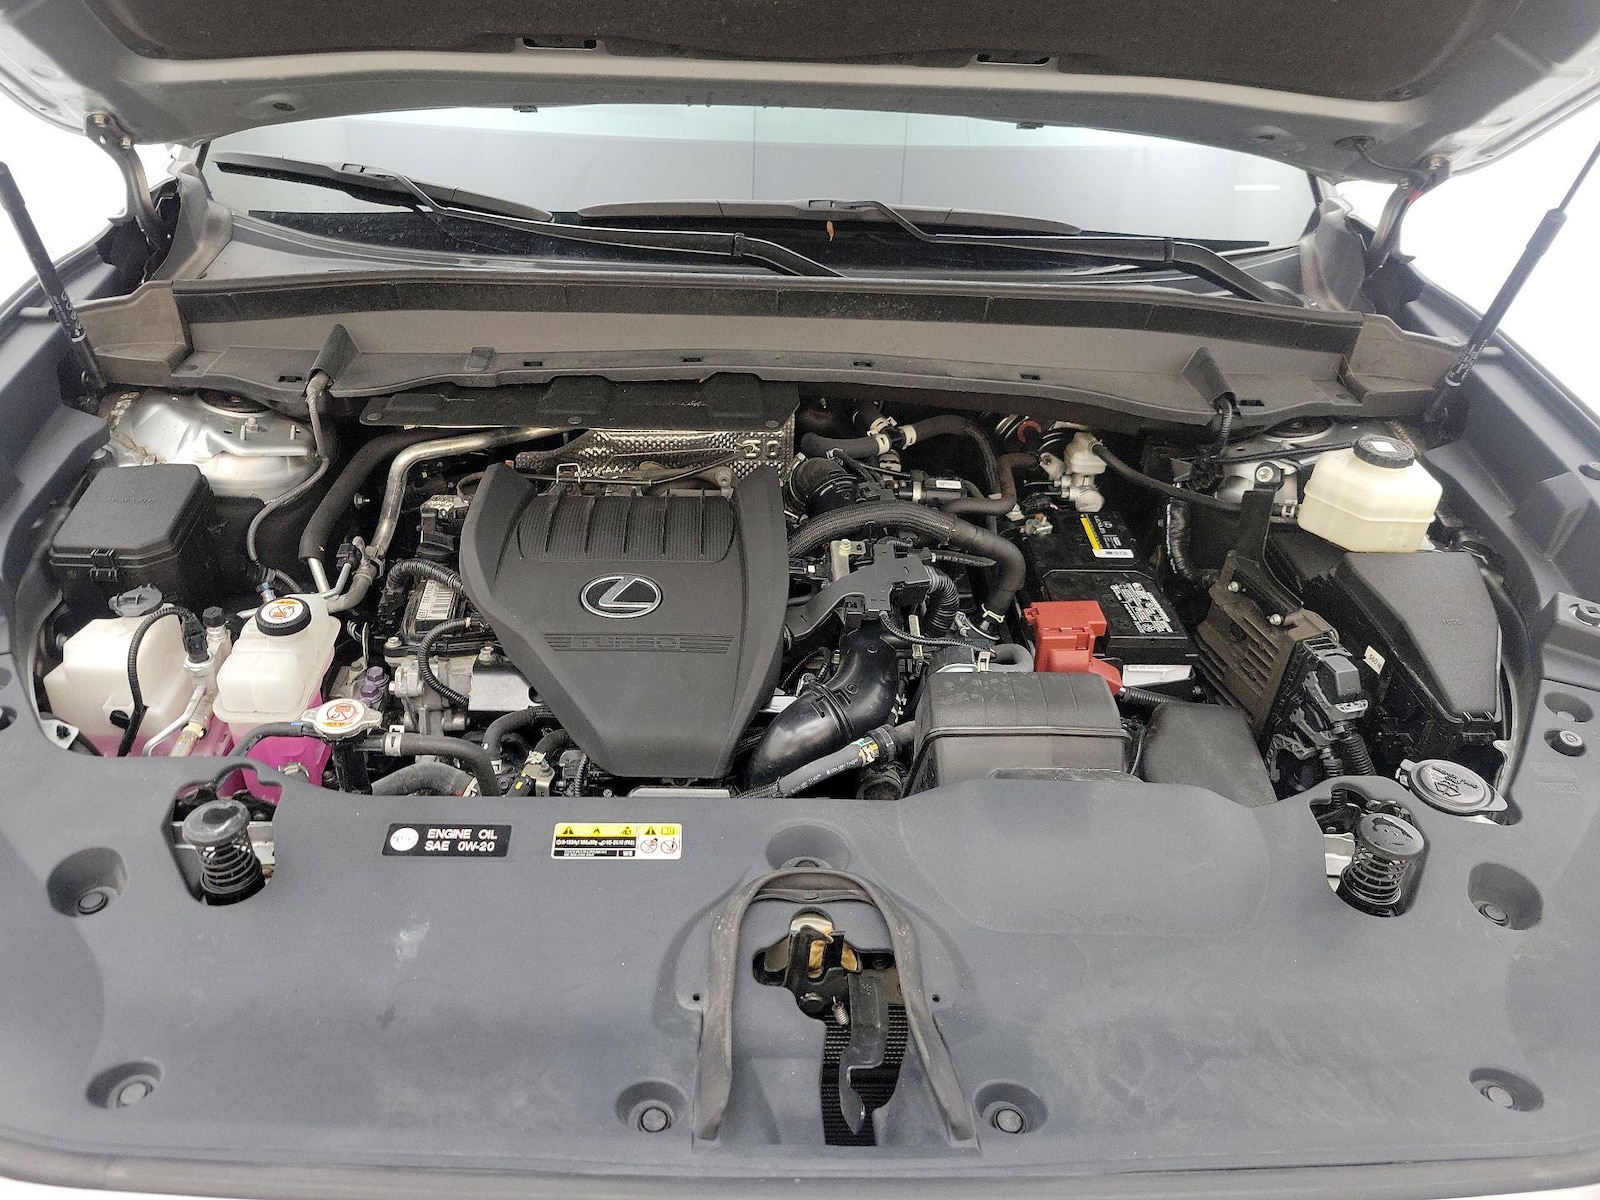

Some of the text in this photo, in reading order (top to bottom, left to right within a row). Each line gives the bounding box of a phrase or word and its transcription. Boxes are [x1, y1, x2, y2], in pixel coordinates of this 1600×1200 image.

[427, 828, 498, 840] ENGINE OIL
[424, 841, 495, 852] SAE 0W-20
